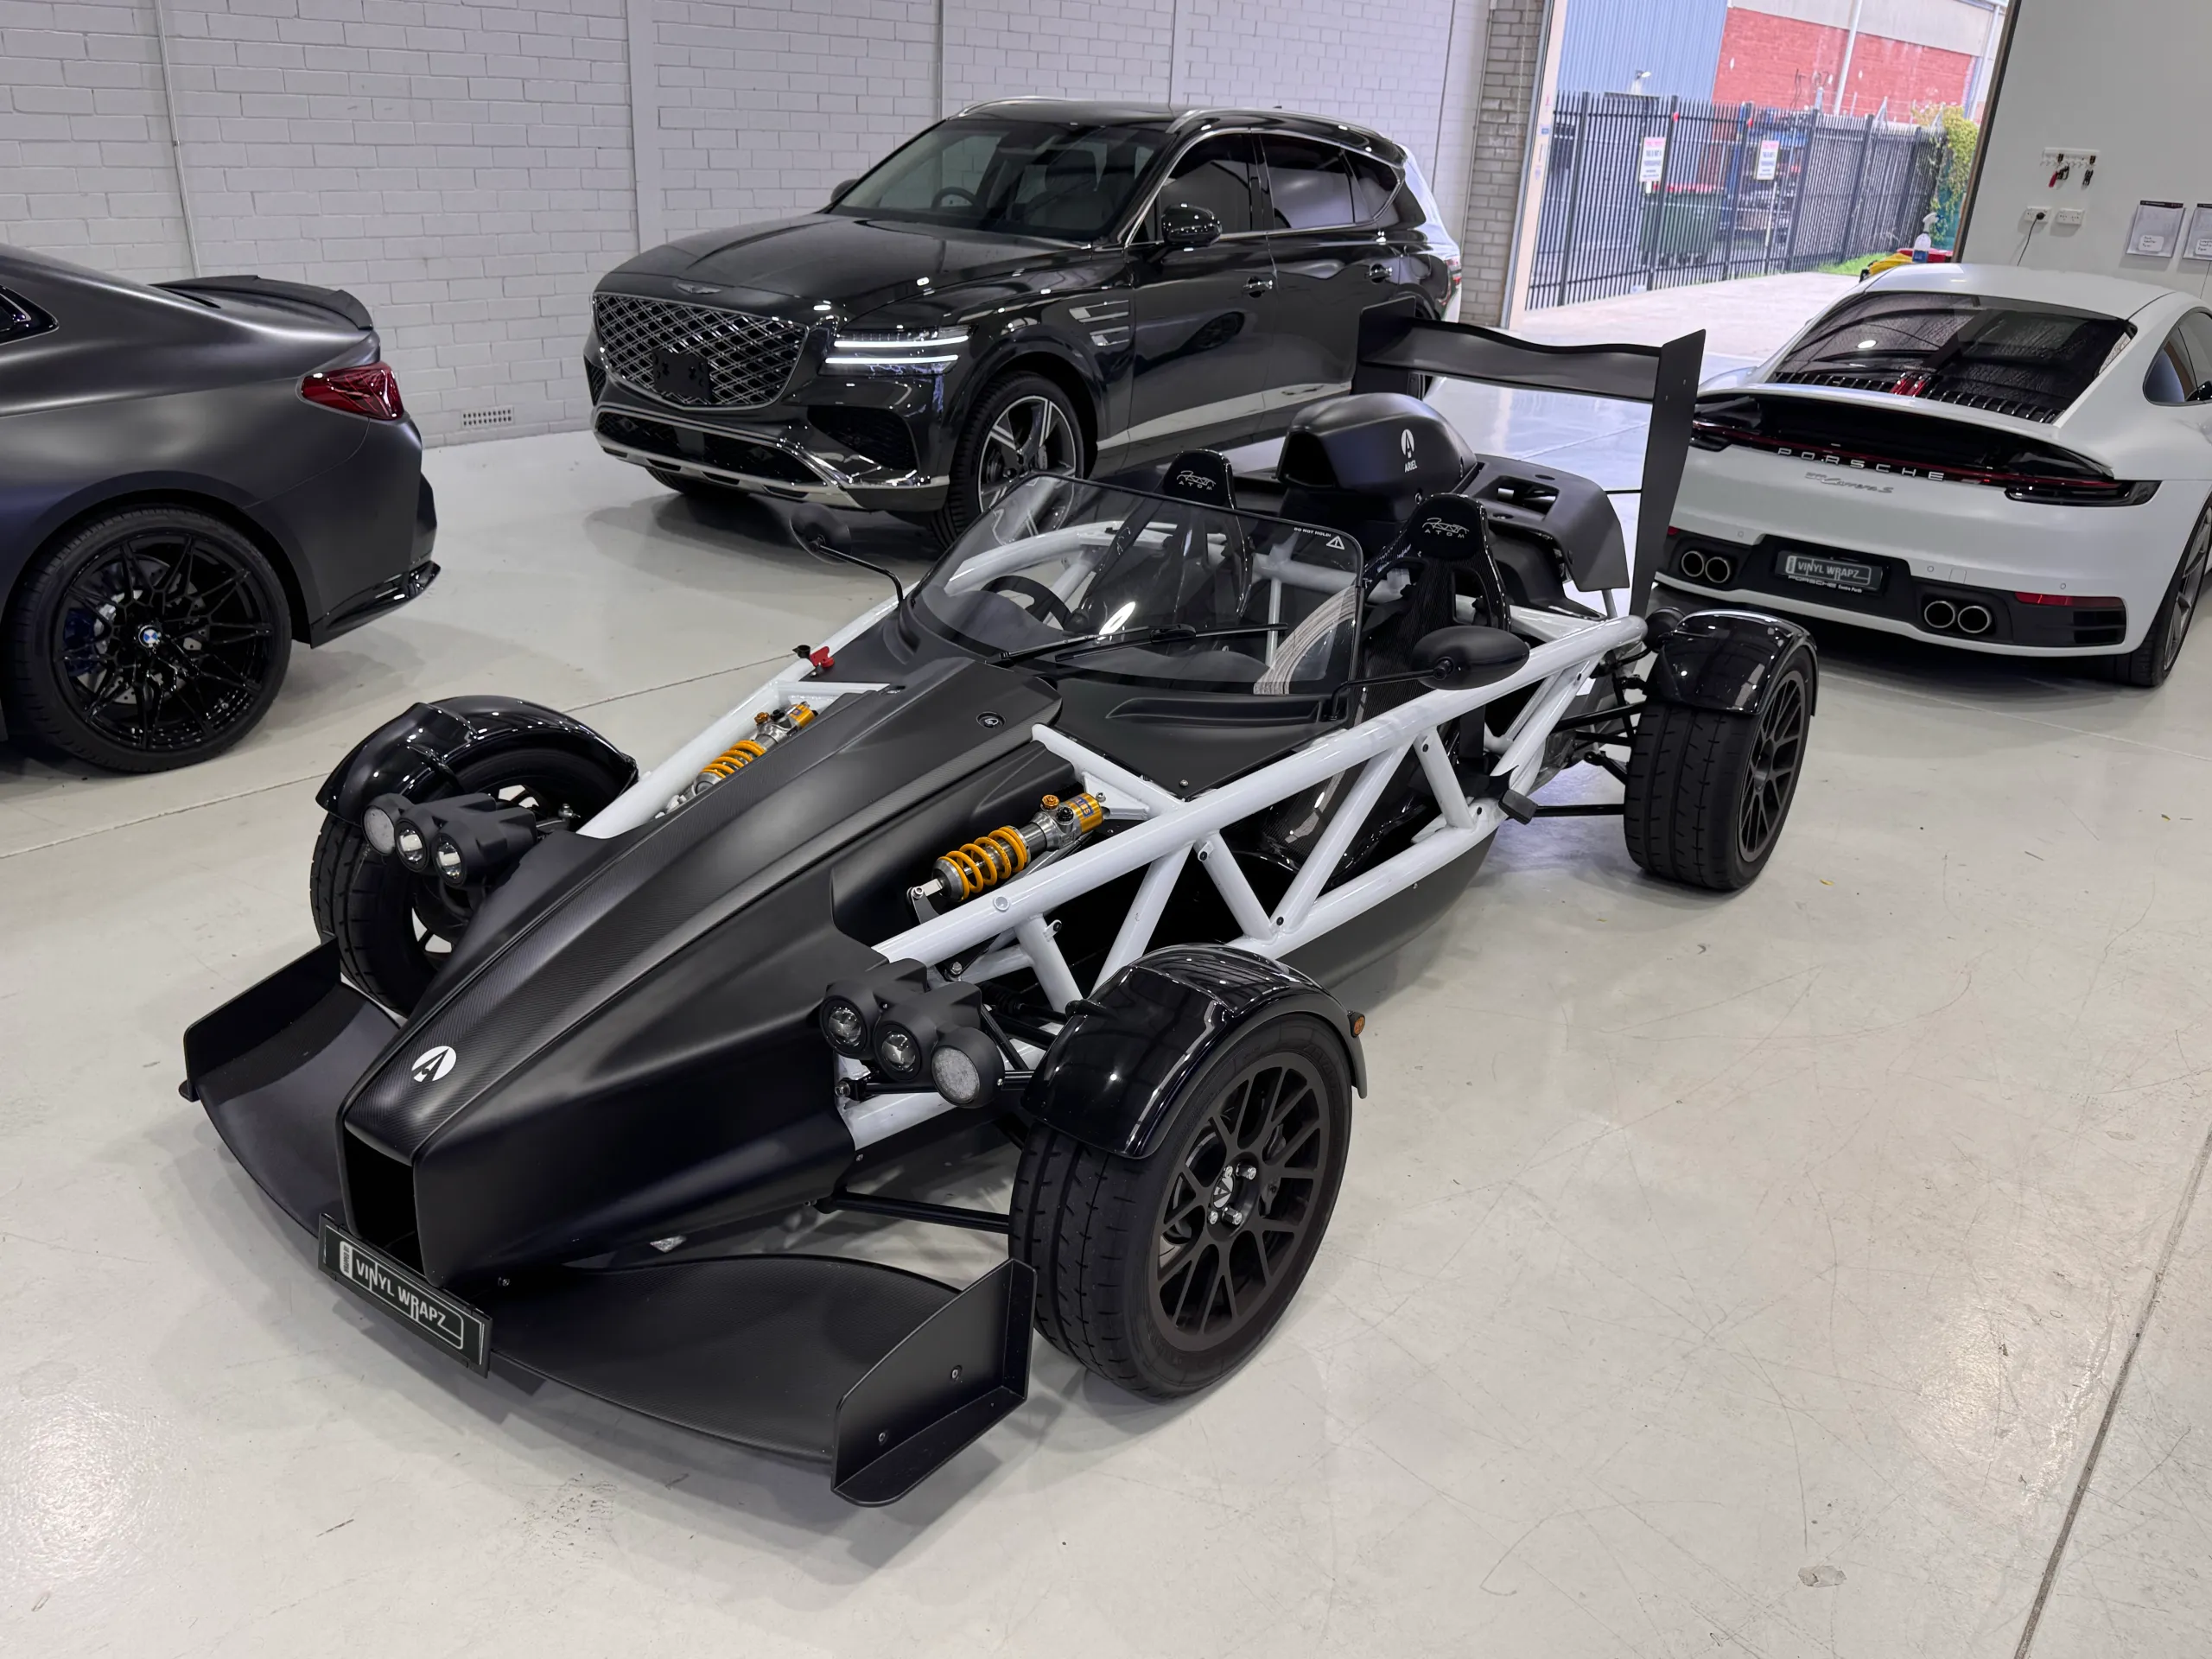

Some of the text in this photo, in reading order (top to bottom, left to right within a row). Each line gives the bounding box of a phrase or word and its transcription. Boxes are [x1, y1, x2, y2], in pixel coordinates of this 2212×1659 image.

[1404, 460, 1418, 473] ARIEL
[1777, 448, 1944, 480] PORSCHE
[1179, 480, 1212, 491] ATOM
[1424, 528, 1465, 538] ATOM
[1798, 561, 1824, 574] VINYL
[1827, 565, 1859, 580] WRAPZ
[1788, 575, 1837, 588] PORSCHE
[356, 1258, 448, 1329] VINYL WRAPZ
